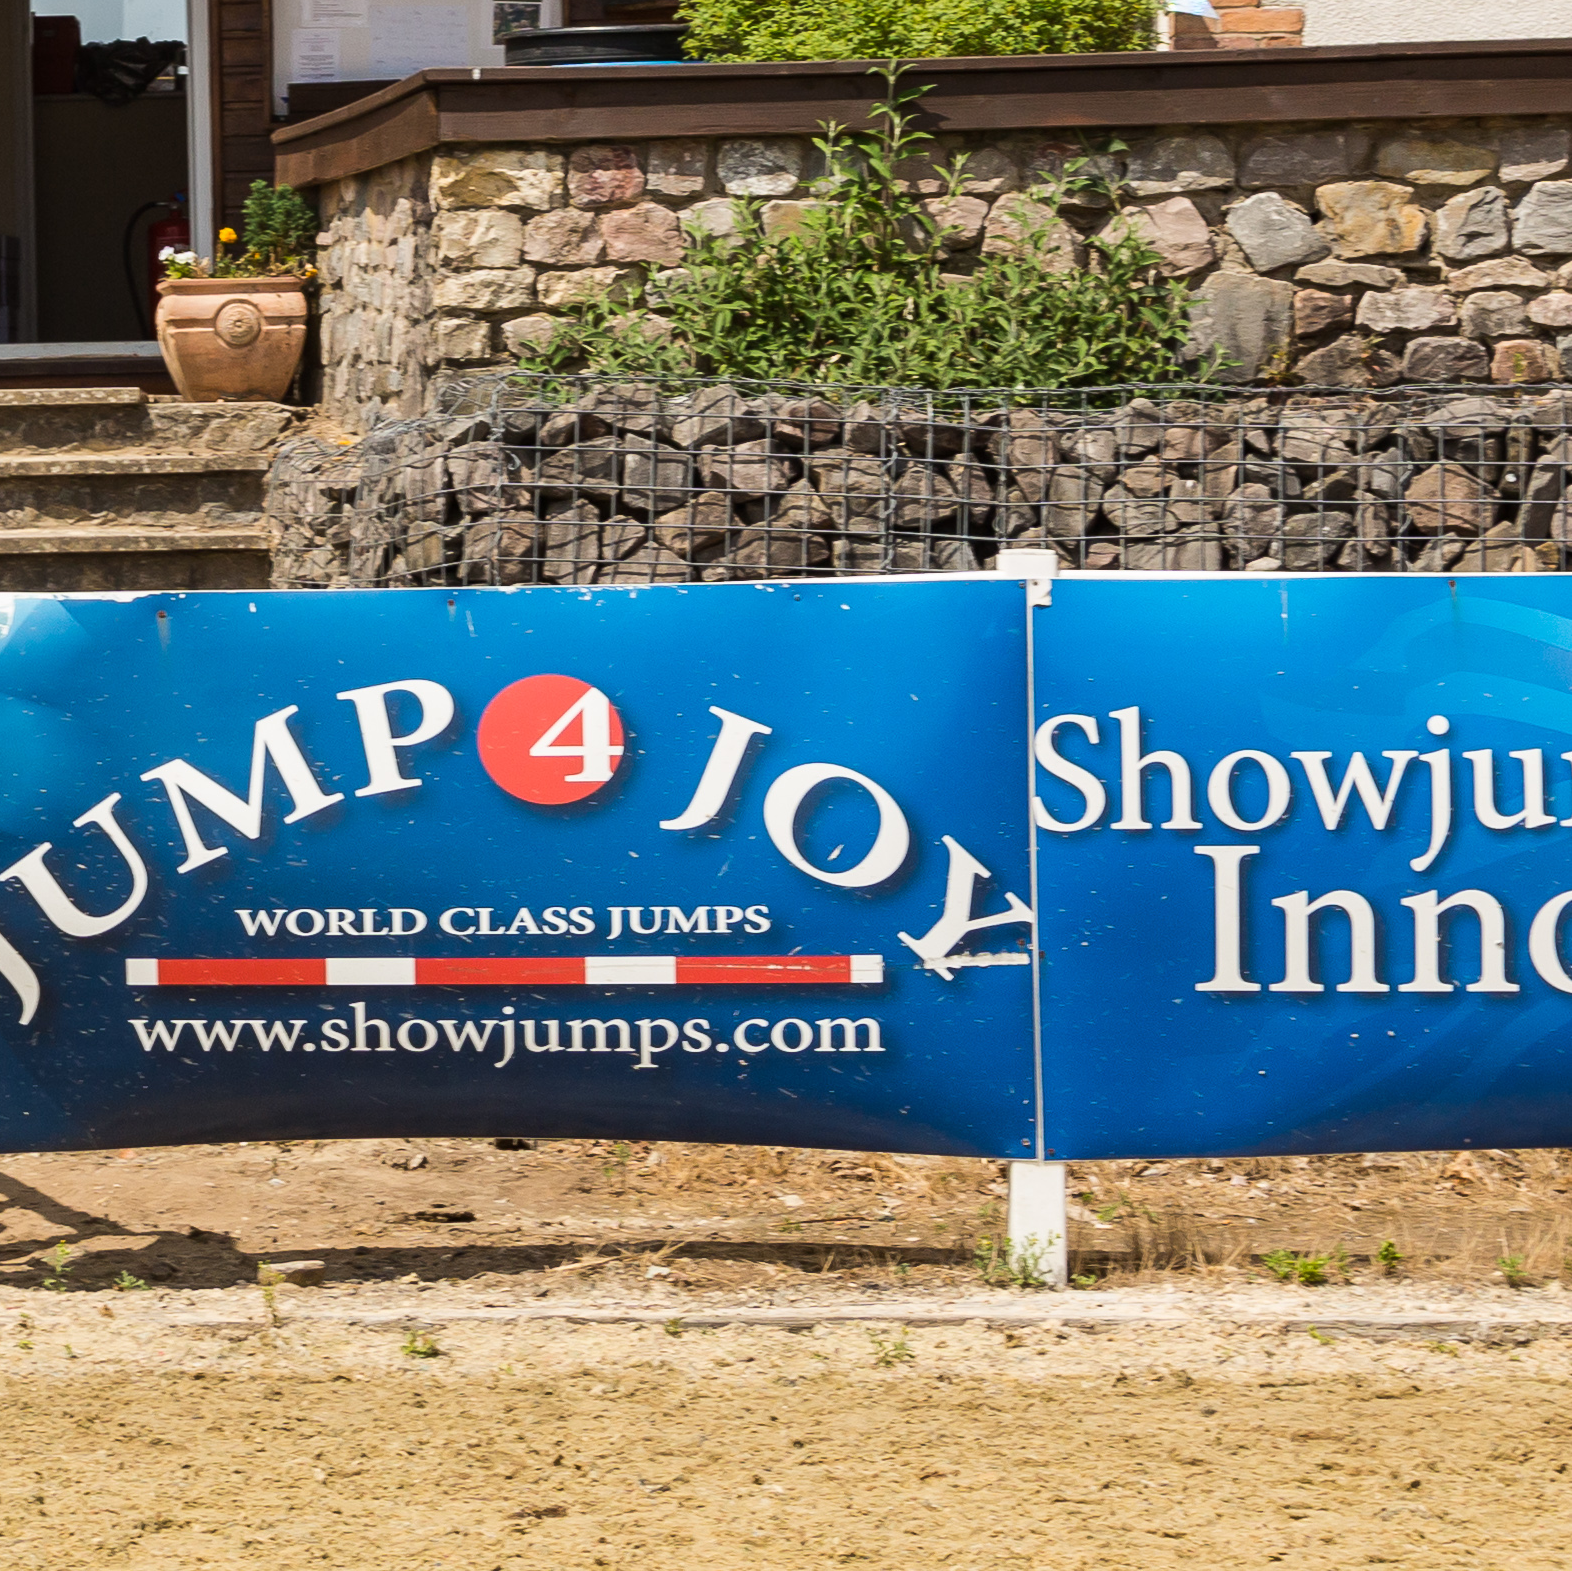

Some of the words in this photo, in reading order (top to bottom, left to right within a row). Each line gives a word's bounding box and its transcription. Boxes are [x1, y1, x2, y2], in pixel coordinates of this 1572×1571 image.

[528, 684, 625, 784] 4
[658, 704, 1035, 982] JOY
[1031, 705, 1572, 872] Showju
[235, 906, 428, 939] WORLD
[440, 903, 597, 937] CLASS
[606, 902, 771, 941] JUMPS
[127, 1000, 887, 1069] www.showjumps.com
